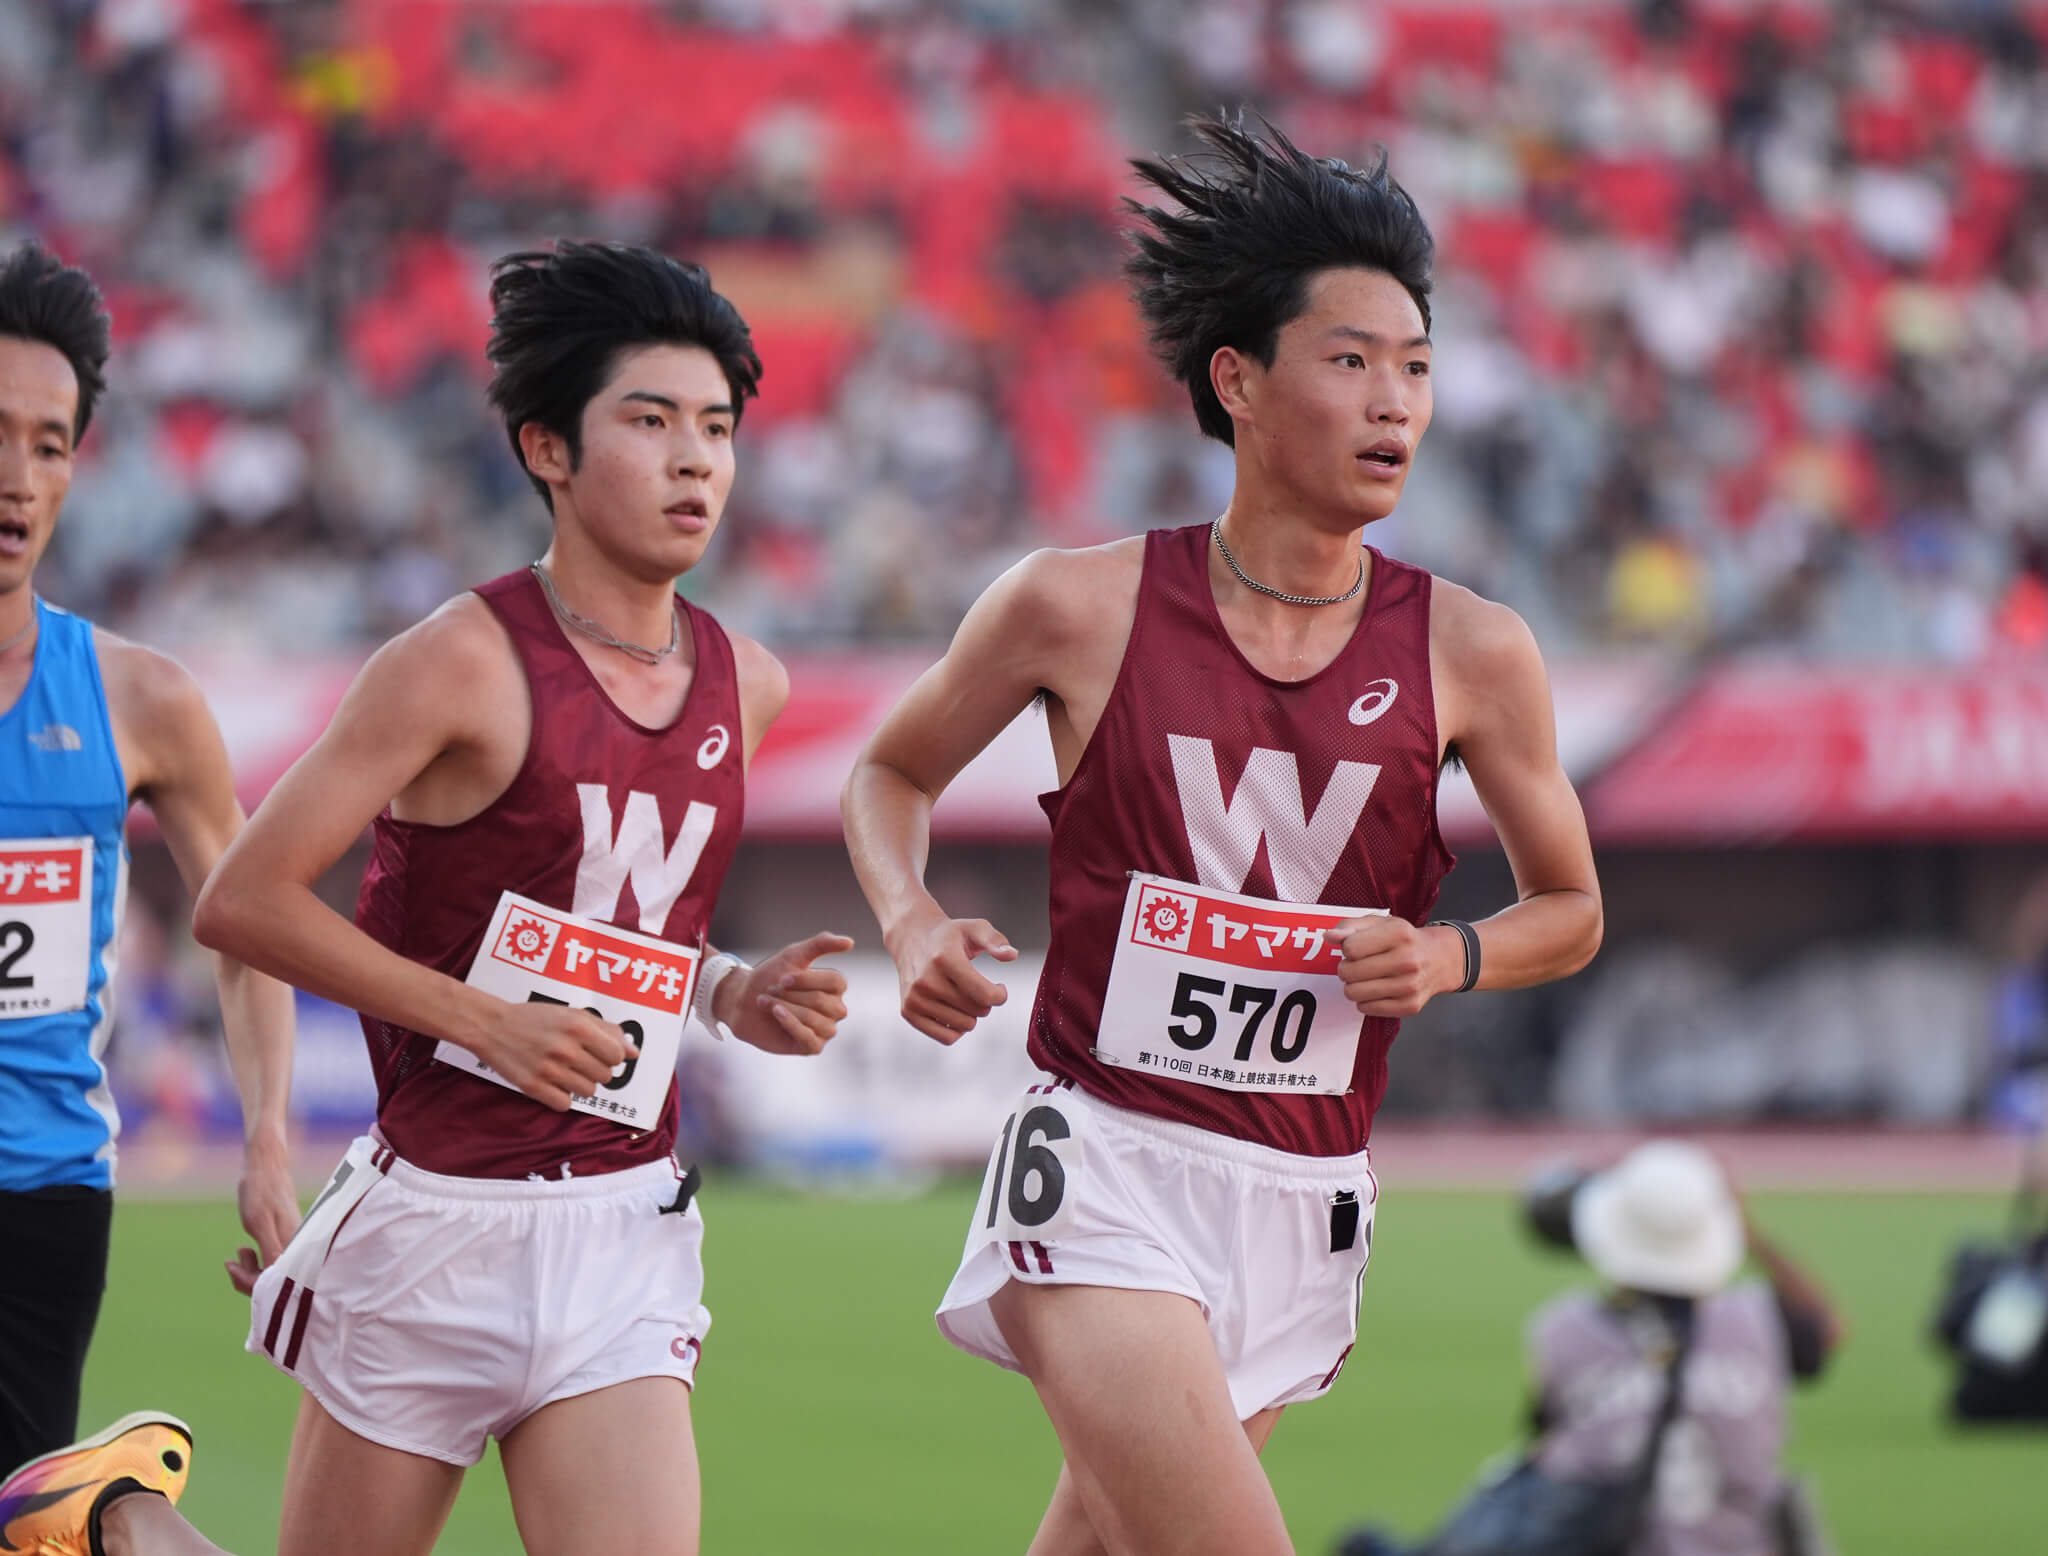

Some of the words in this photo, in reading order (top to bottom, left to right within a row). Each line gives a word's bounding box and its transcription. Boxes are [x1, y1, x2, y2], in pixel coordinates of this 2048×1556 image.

[571, 783, 717, 936] W
[1167, 733, 1382, 905] W
[564, 937, 684, 1001] ヤマザキ
[1167, 972, 1317, 1064] 570
[1138, 1051, 1192, 1074] 第110回
[1197, 1064, 1317, 1087] 日本陸上競技選手権大会
[986, 1105, 1071, 1229] 16
